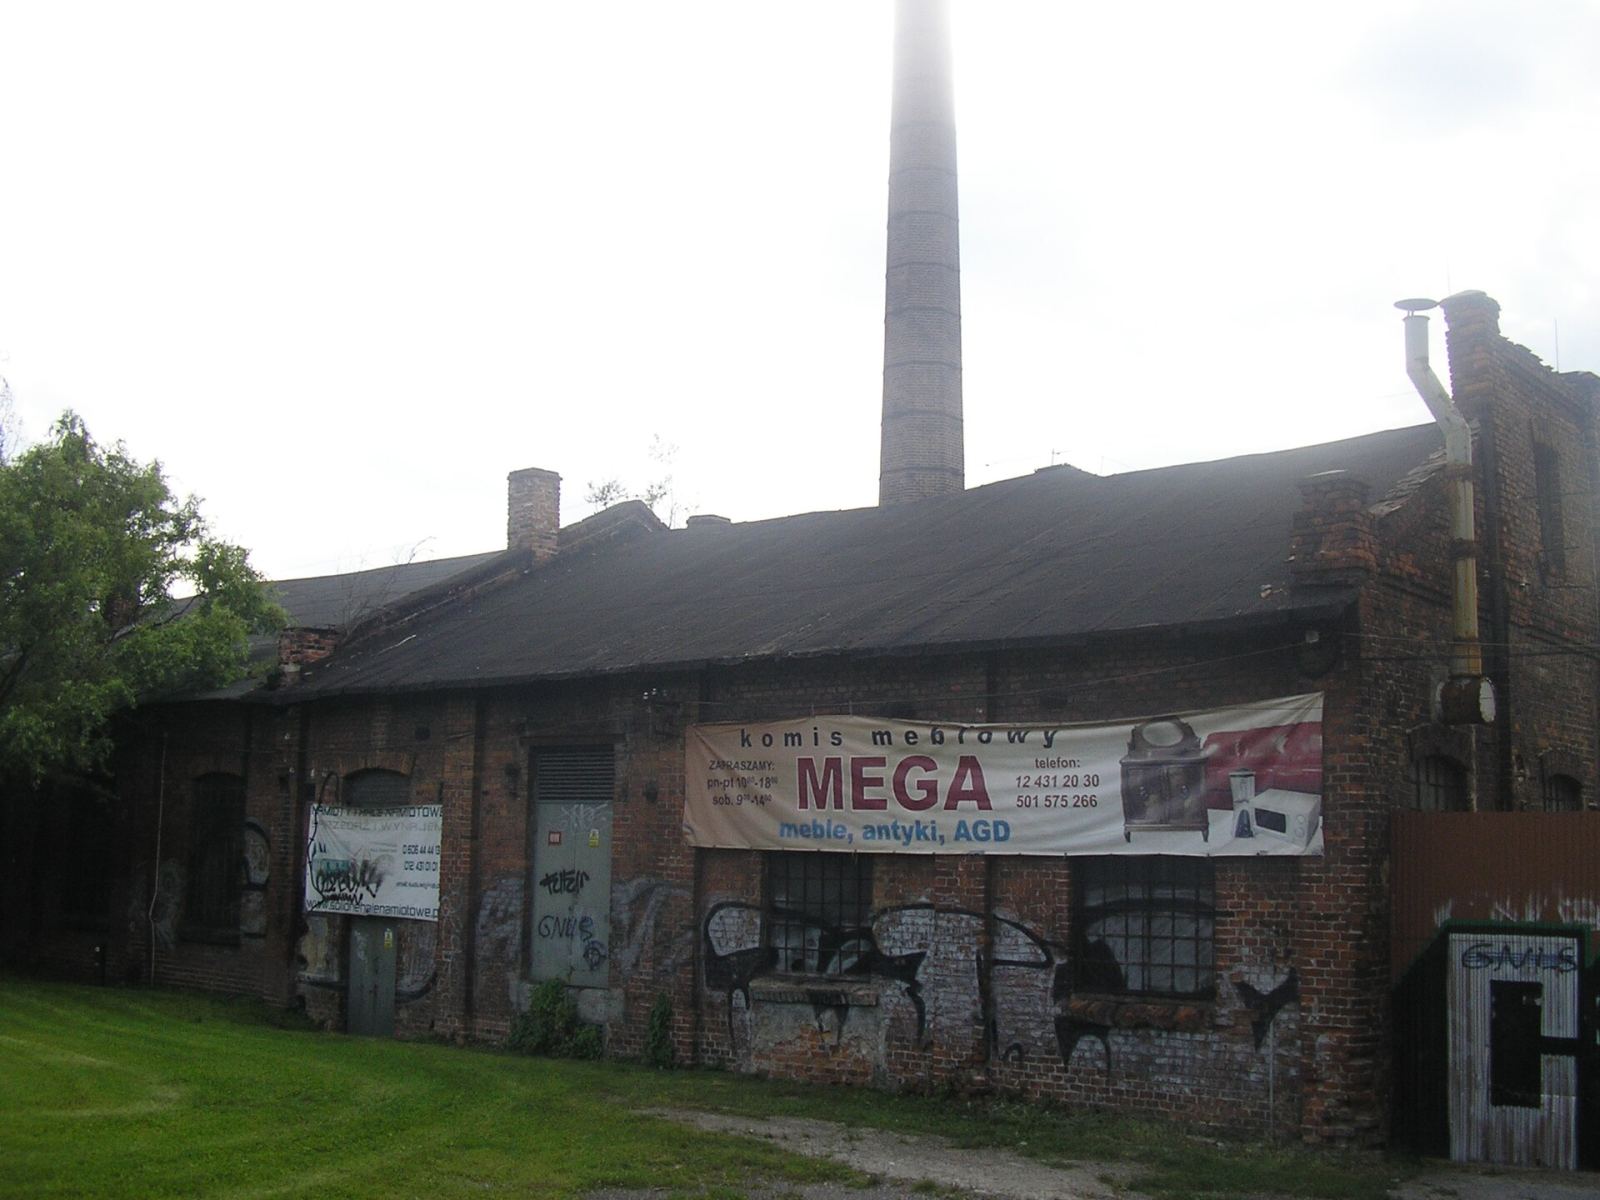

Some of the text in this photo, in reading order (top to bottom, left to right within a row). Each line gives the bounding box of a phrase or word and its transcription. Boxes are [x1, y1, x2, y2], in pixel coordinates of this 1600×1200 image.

[740, 727, 842, 748] komis
[709, 760, 775, 770] ZAPRASZAMY:
[1035, 757, 1080, 769] telefon:
[797, 754, 993, 811] MEGA
[1016, 774, 1100, 788] 12 431 20 30
[1016, 795, 1098, 808] 501 575 266
[779, 819, 1010, 845] meble, antyki, AGD
